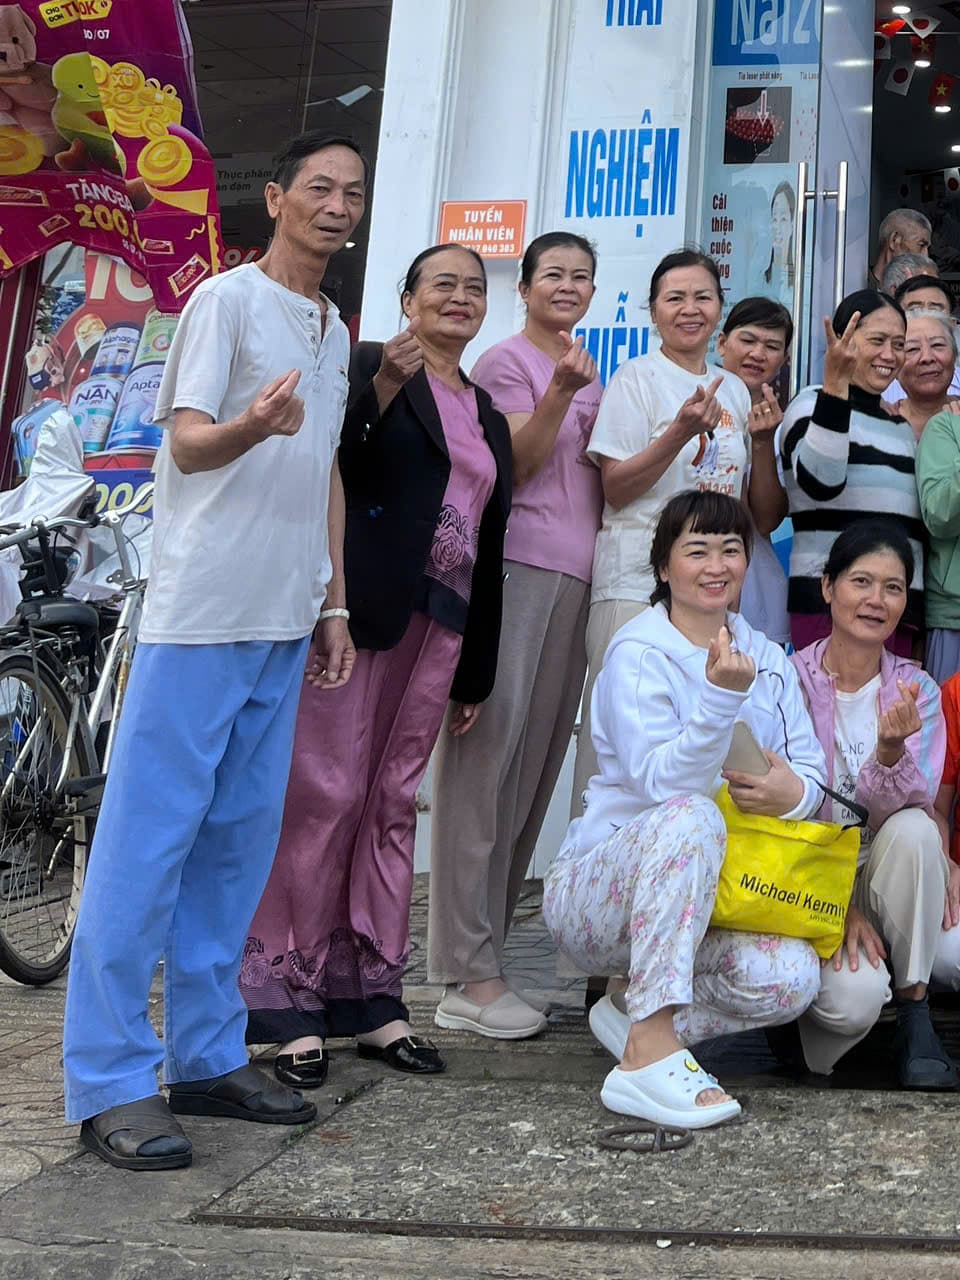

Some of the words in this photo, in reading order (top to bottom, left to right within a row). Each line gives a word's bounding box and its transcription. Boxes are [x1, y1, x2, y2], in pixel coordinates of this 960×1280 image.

[564, 109, 680, 238] NGHIỆM
[712, 192, 727, 210] Cải
[449, 225, 483, 241] NHÂN
[487, 225, 515, 240] VIÊN
[711, 215, 734, 236] thiện
[710, 238, 732, 258] cuộc
[129, 379, 161, 393] Apta
[75, 387, 119, 405] NAN
[740, 873, 801, 906] Michael
